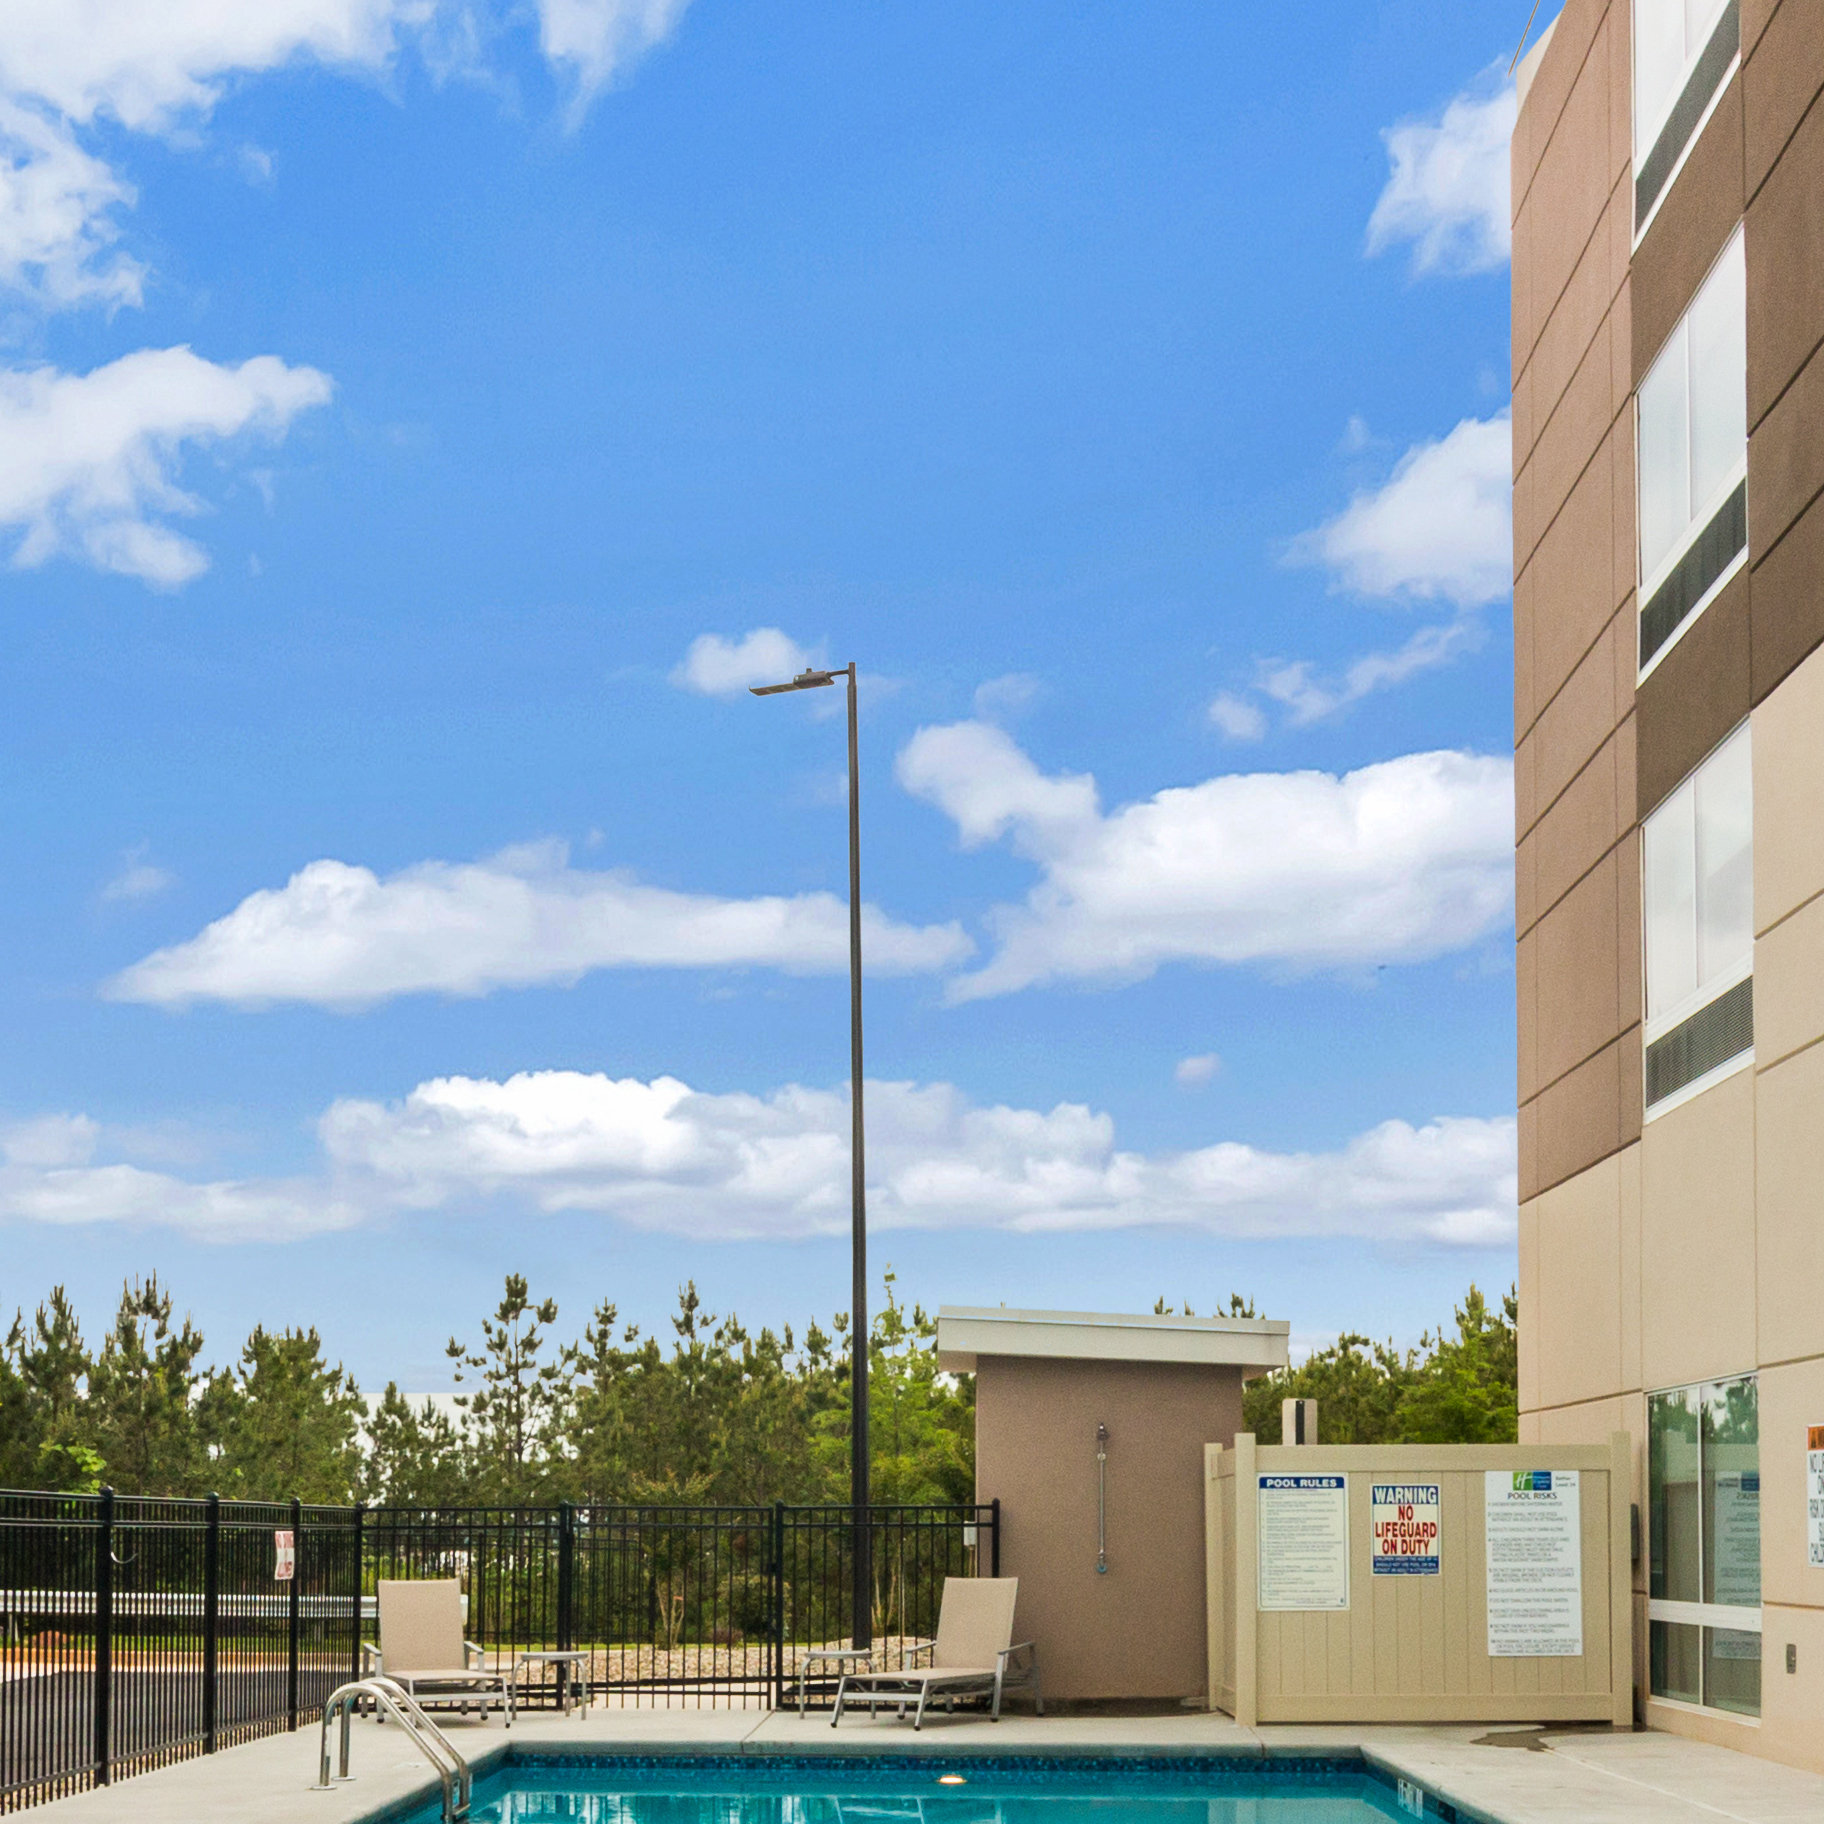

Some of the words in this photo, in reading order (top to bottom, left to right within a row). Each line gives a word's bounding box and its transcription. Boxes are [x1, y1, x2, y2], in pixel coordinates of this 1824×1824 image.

[1266, 1479, 1296, 1487] POOL
[1300, 1479, 1337, 1487] RULES
[1374, 1487, 1436, 1504] WARNING
[1507, 1492, 1531, 1500] POOL
[1533, 1492, 1558, 1500] RISKS
[1398, 1505, 1413, 1521] NO
[1375, 1522, 1437, 1537] LIFEGUARD
[1382, 1539, 1397, 1554] ON
[1401, 1539, 1430, 1554] DUTY
